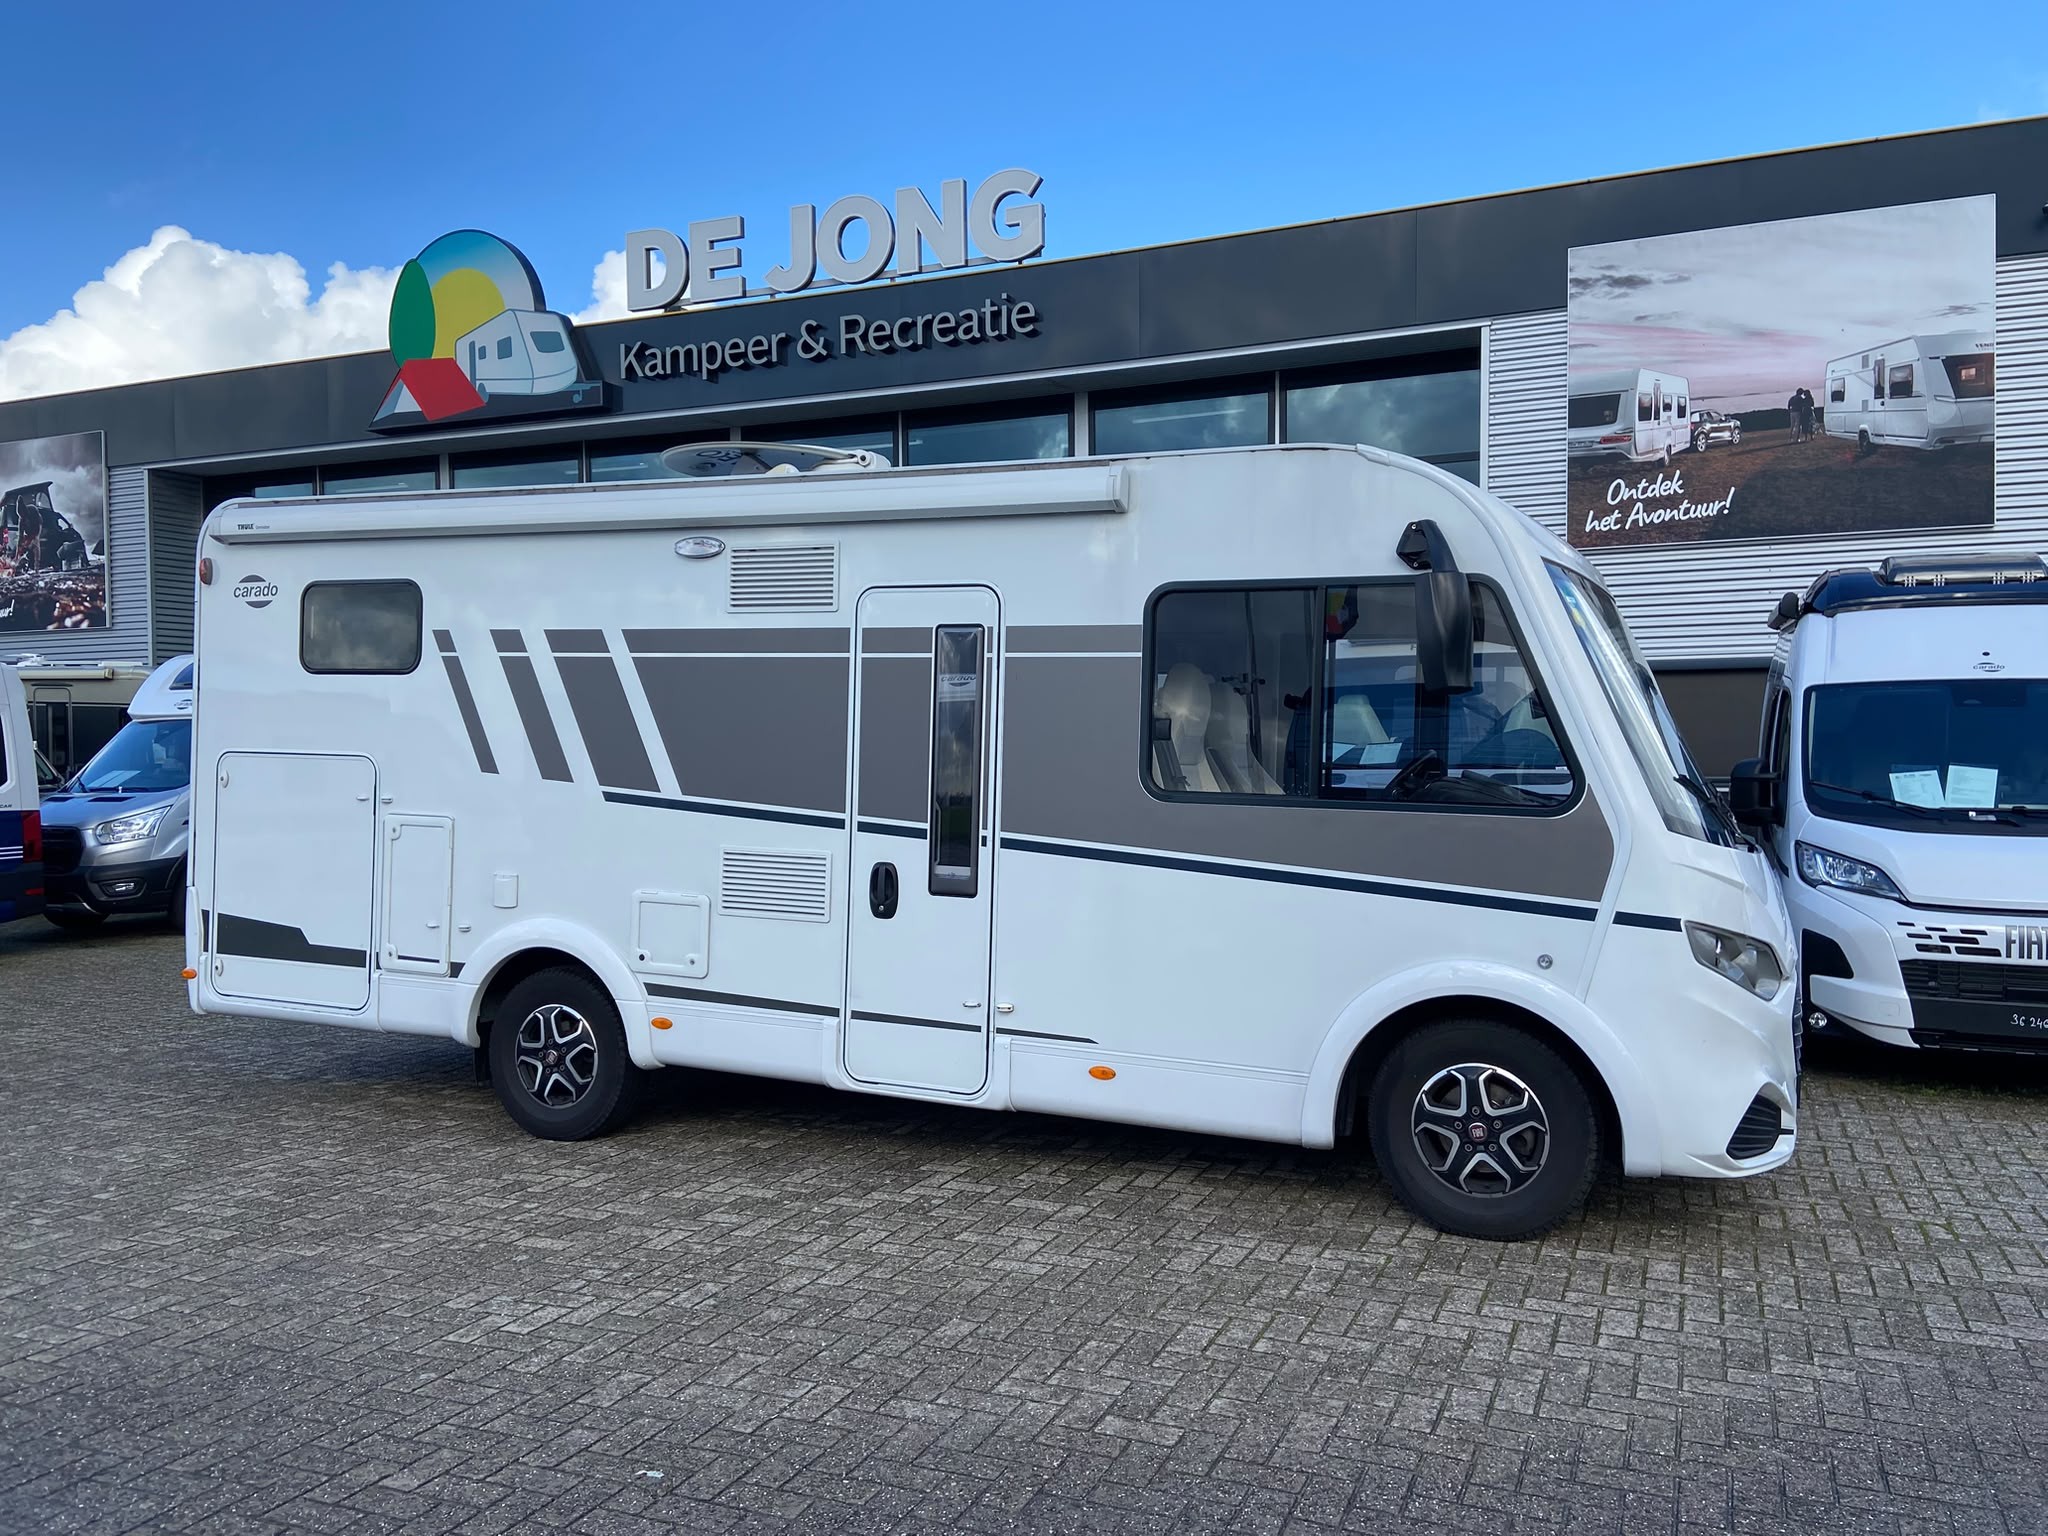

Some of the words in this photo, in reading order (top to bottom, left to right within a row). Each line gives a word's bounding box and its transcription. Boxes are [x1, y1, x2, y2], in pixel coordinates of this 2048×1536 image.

[626, 215, 747, 312] DE
[764, 168, 1046, 295] JONG
[619, 330, 787, 381] Kampeer
[797, 319, 828, 360] &
[839, 293, 1037, 355] Recreatie
[1584, 509, 1622, 533] het
[1624, 486, 1736, 531] Avontuur!
[1606, 469, 1685, 506] Ontdek
[233, 582, 279, 598] carado
